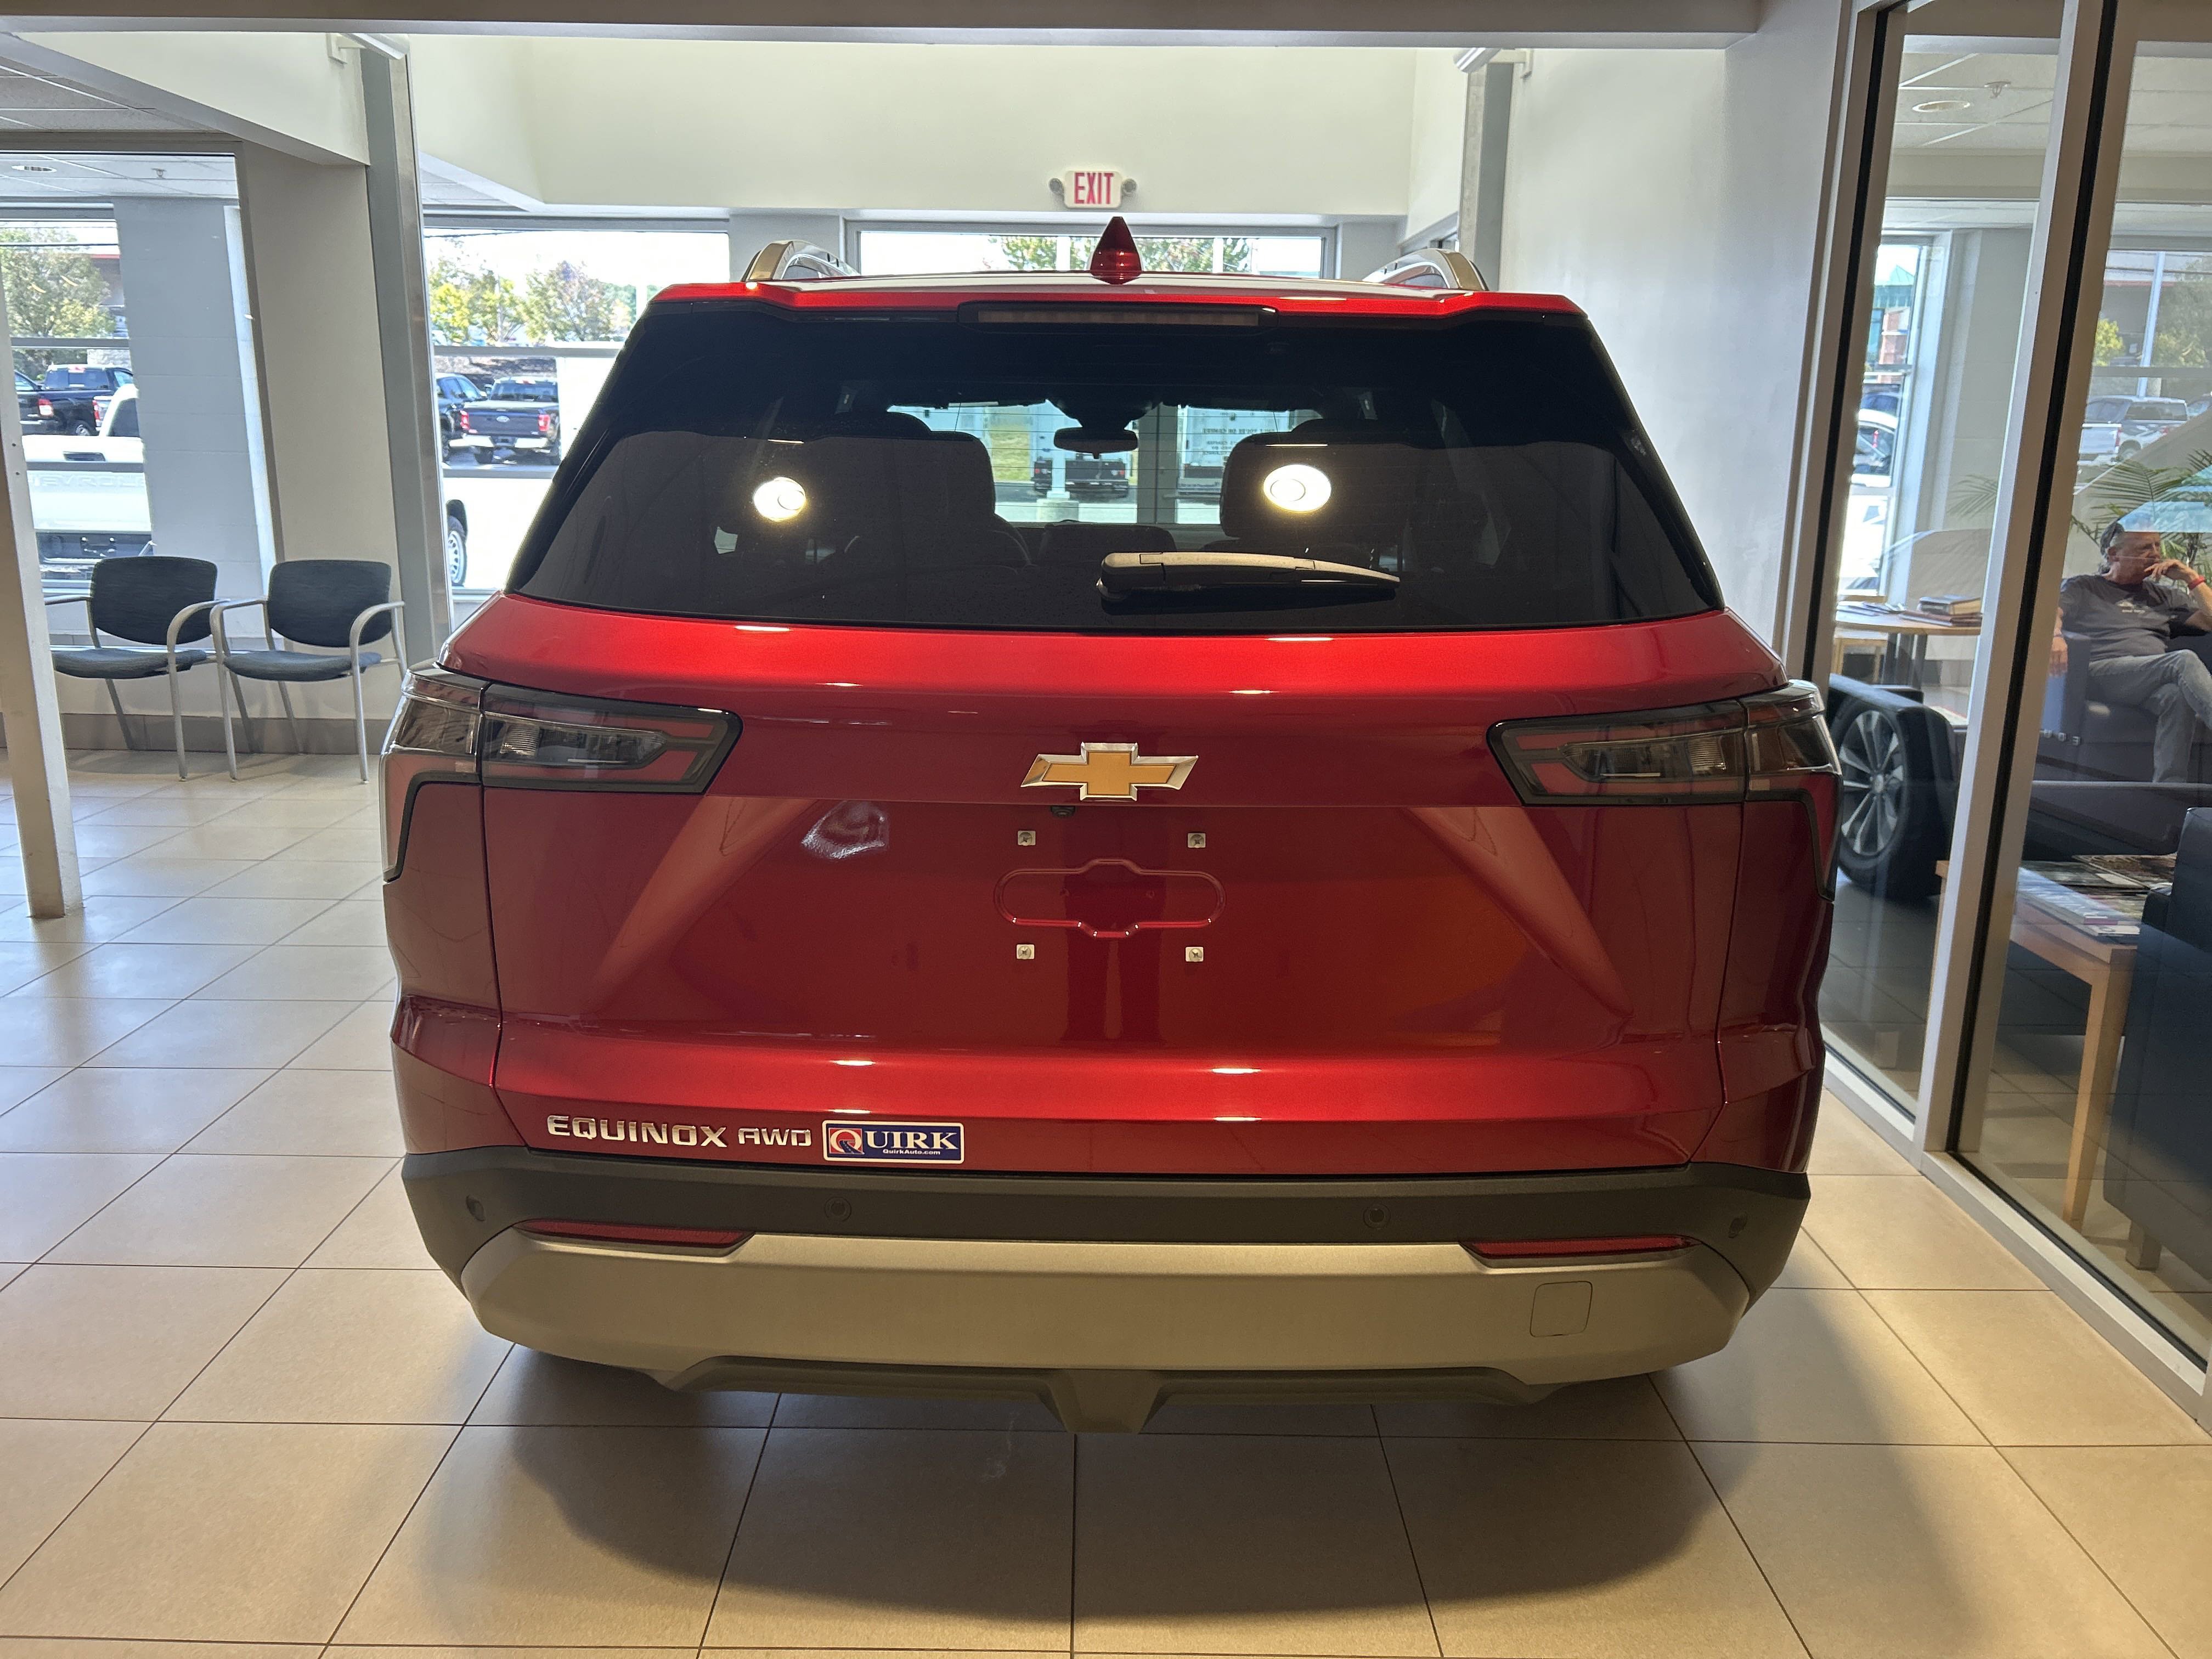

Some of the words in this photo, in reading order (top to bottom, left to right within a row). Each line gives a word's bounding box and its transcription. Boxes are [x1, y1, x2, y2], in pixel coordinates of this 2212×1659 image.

[1074, 172, 1114, 204] EXIT
[547, 1115, 727, 1147] EQUINOX
[738, 1128, 811, 1146] AWD
[830, 1129, 958, 1154] QUIRK
